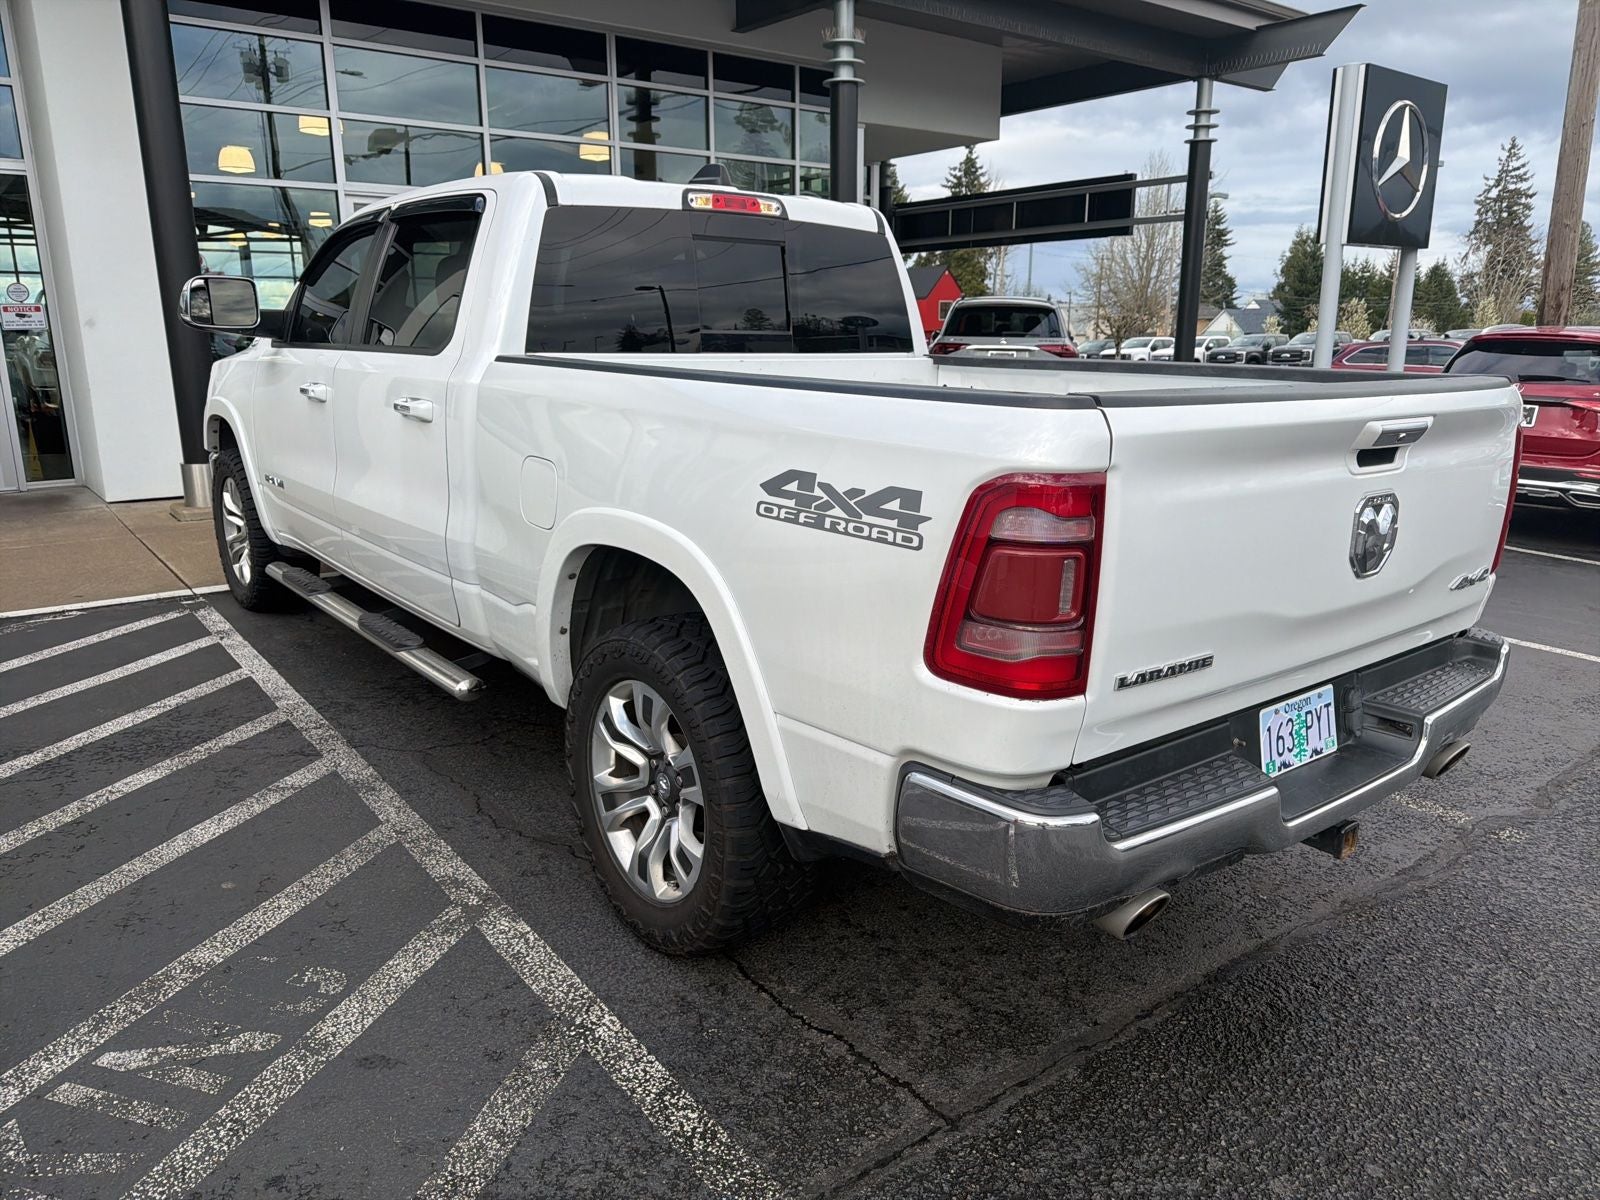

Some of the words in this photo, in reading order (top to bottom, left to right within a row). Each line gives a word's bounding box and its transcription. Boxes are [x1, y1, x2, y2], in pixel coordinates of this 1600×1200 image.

[759, 503, 818, 525] OFF
[824, 517, 920, 548] ROAD
[1113, 653, 1214, 691] LARAMIE
[1284, 695, 1312, 714] Oregon
